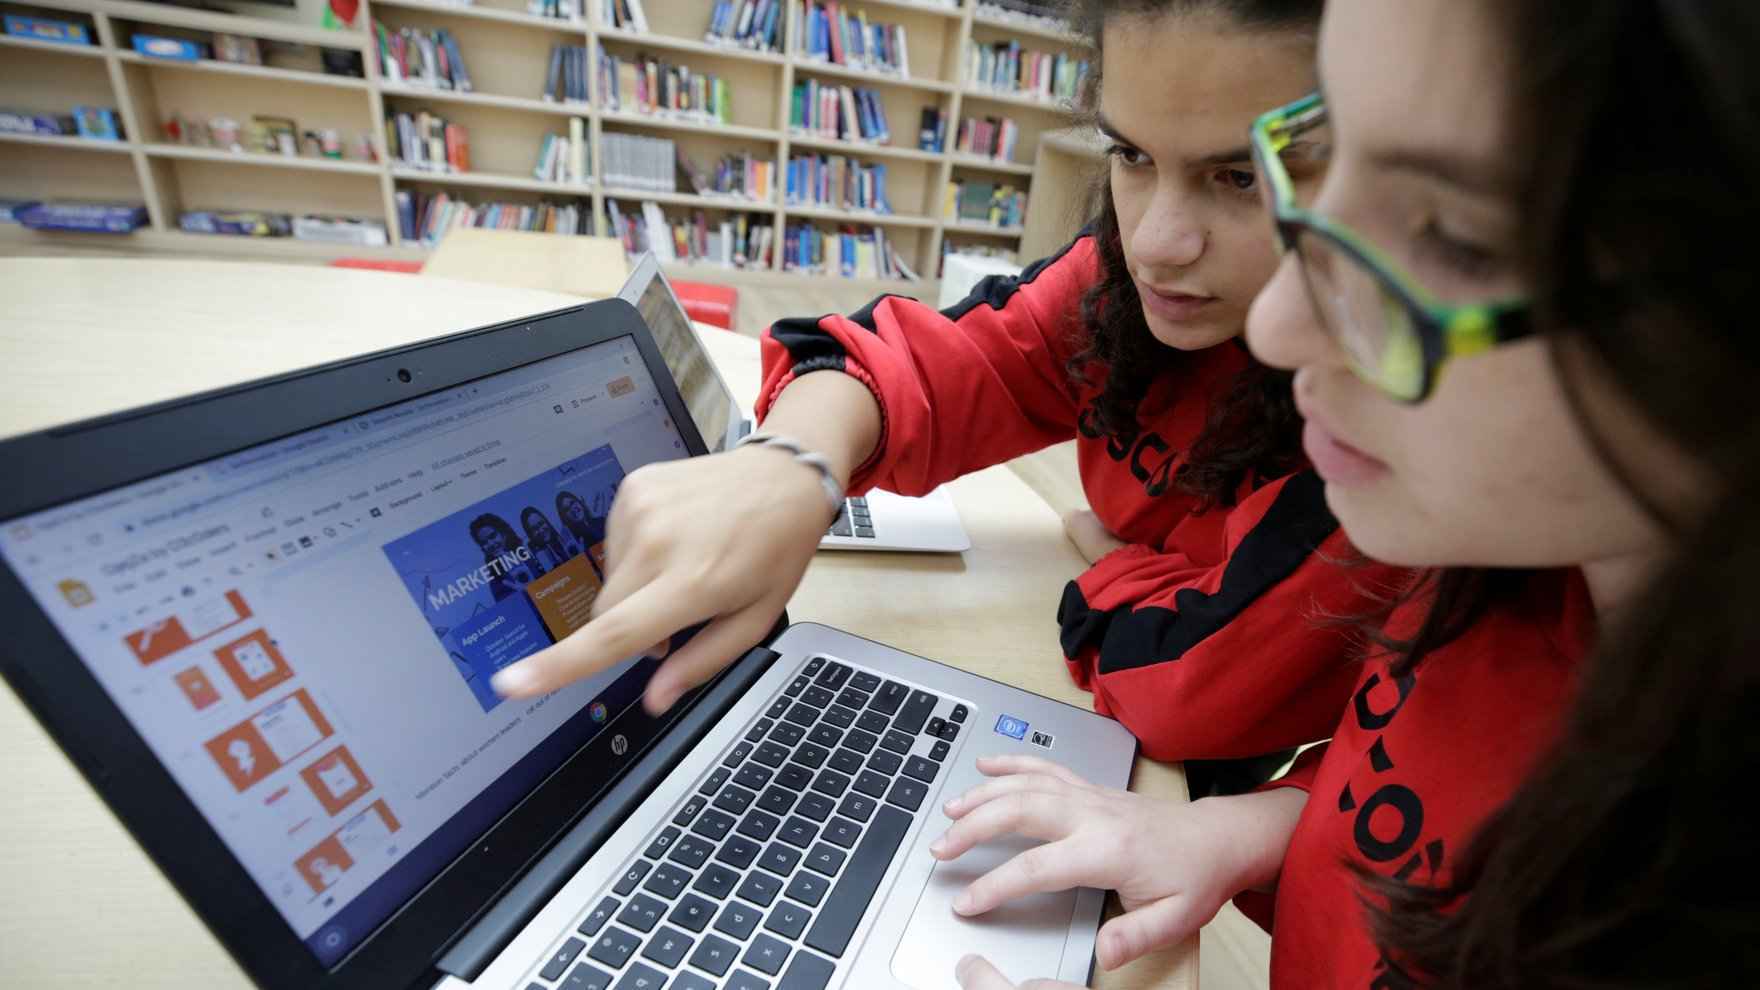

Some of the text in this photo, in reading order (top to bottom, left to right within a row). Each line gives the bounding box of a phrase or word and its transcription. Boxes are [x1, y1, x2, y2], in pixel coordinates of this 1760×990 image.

[428, 546, 531, 611] MARKETING
[461, 630, 480, 646] App
[481, 615, 506, 636] Launch
[763, 948, 772, 956] x
[853, 801, 862, 809] m
